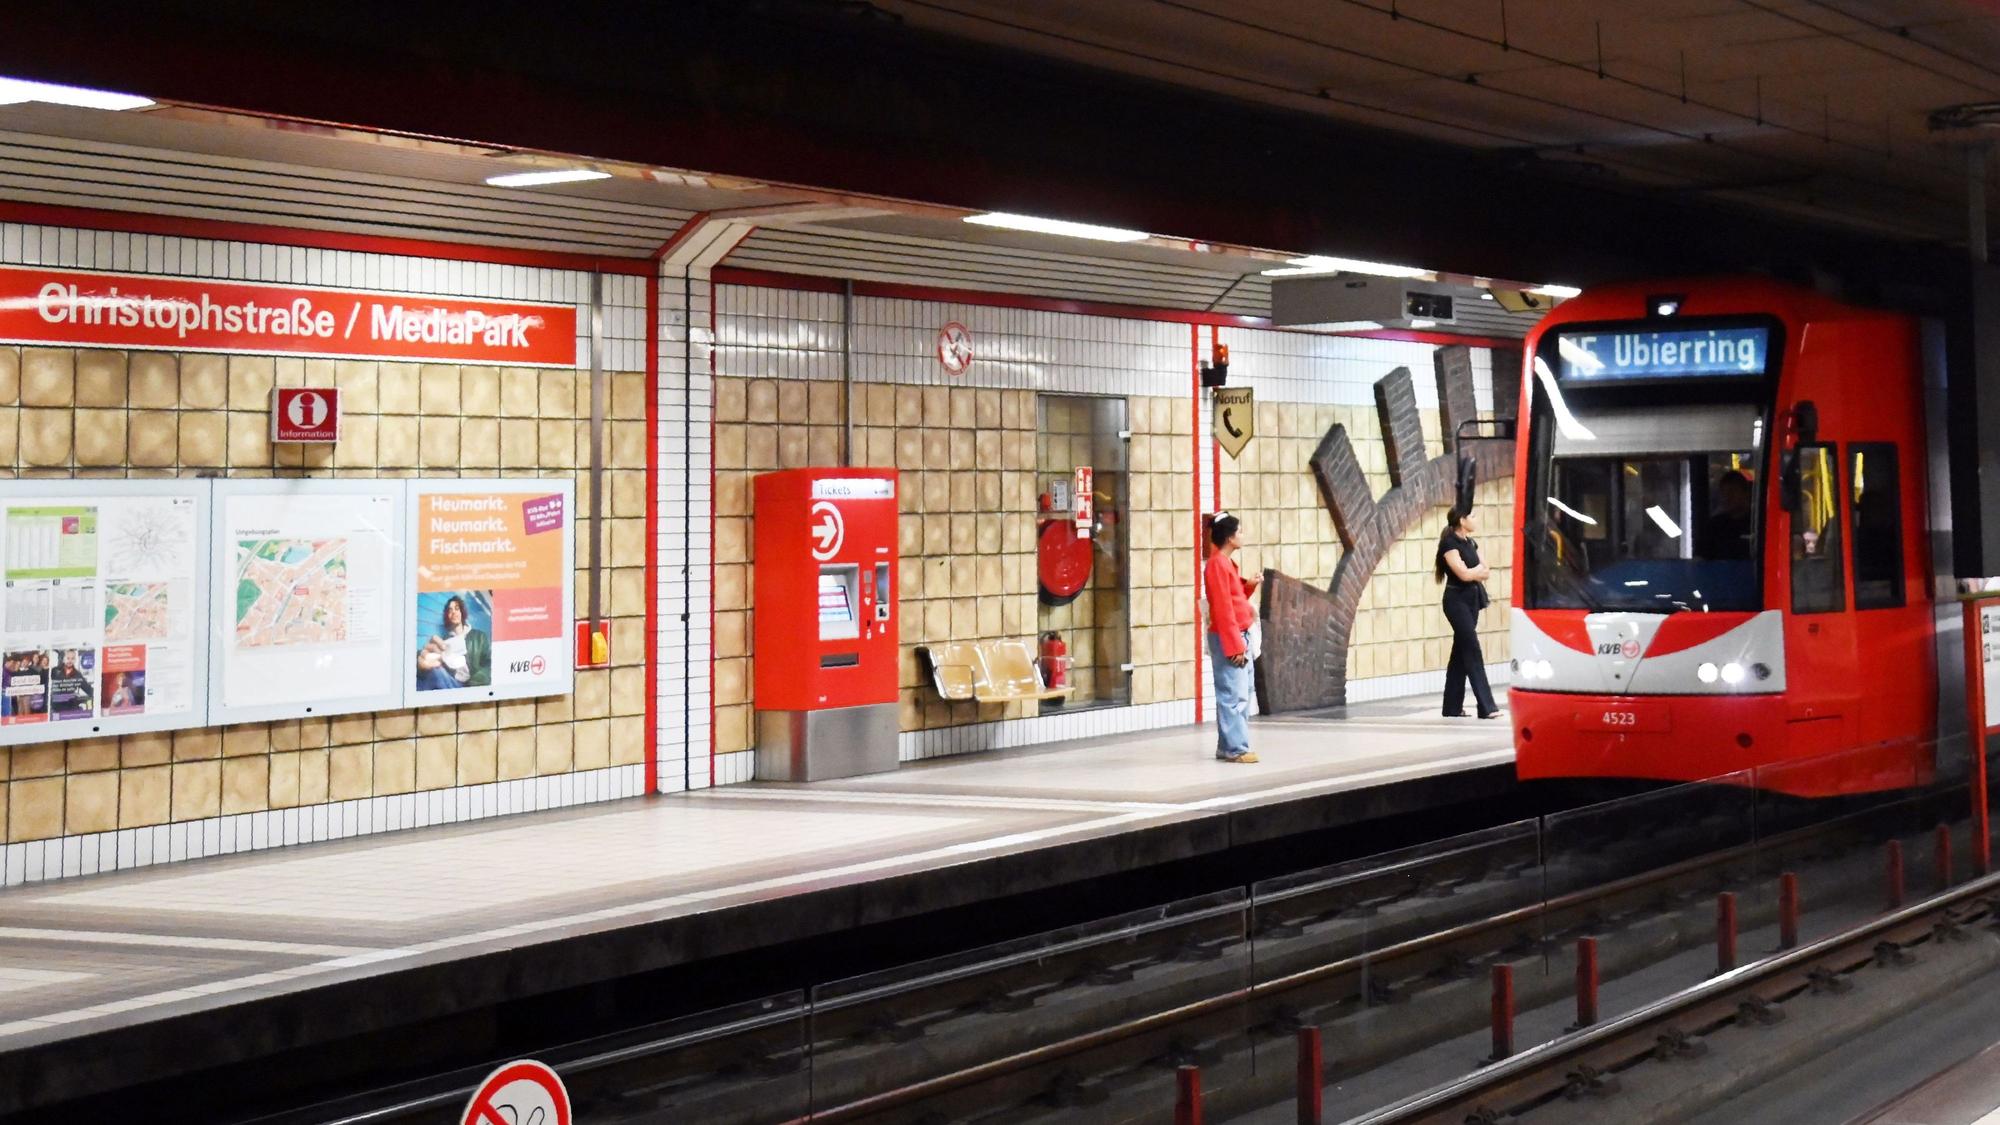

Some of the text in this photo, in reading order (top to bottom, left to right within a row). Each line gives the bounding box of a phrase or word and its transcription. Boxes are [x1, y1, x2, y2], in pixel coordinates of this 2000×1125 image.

[38, 282, 530, 348] Christophstraße / MediaPark
[1615, 331, 1756, 370] Ubierring
[1215, 392, 1250, 404] Notruf
[280, 430, 334, 438] Information
[431, 495, 508, 511] Heumarkt.
[431, 517, 508, 533] Neumarkt.
[431, 538, 516, 554] Fischmarkt.
[1598, 643, 1621, 655] KVB
[510, 660, 530, 673] KVB
[1603, 711, 1635, 725] 4523
